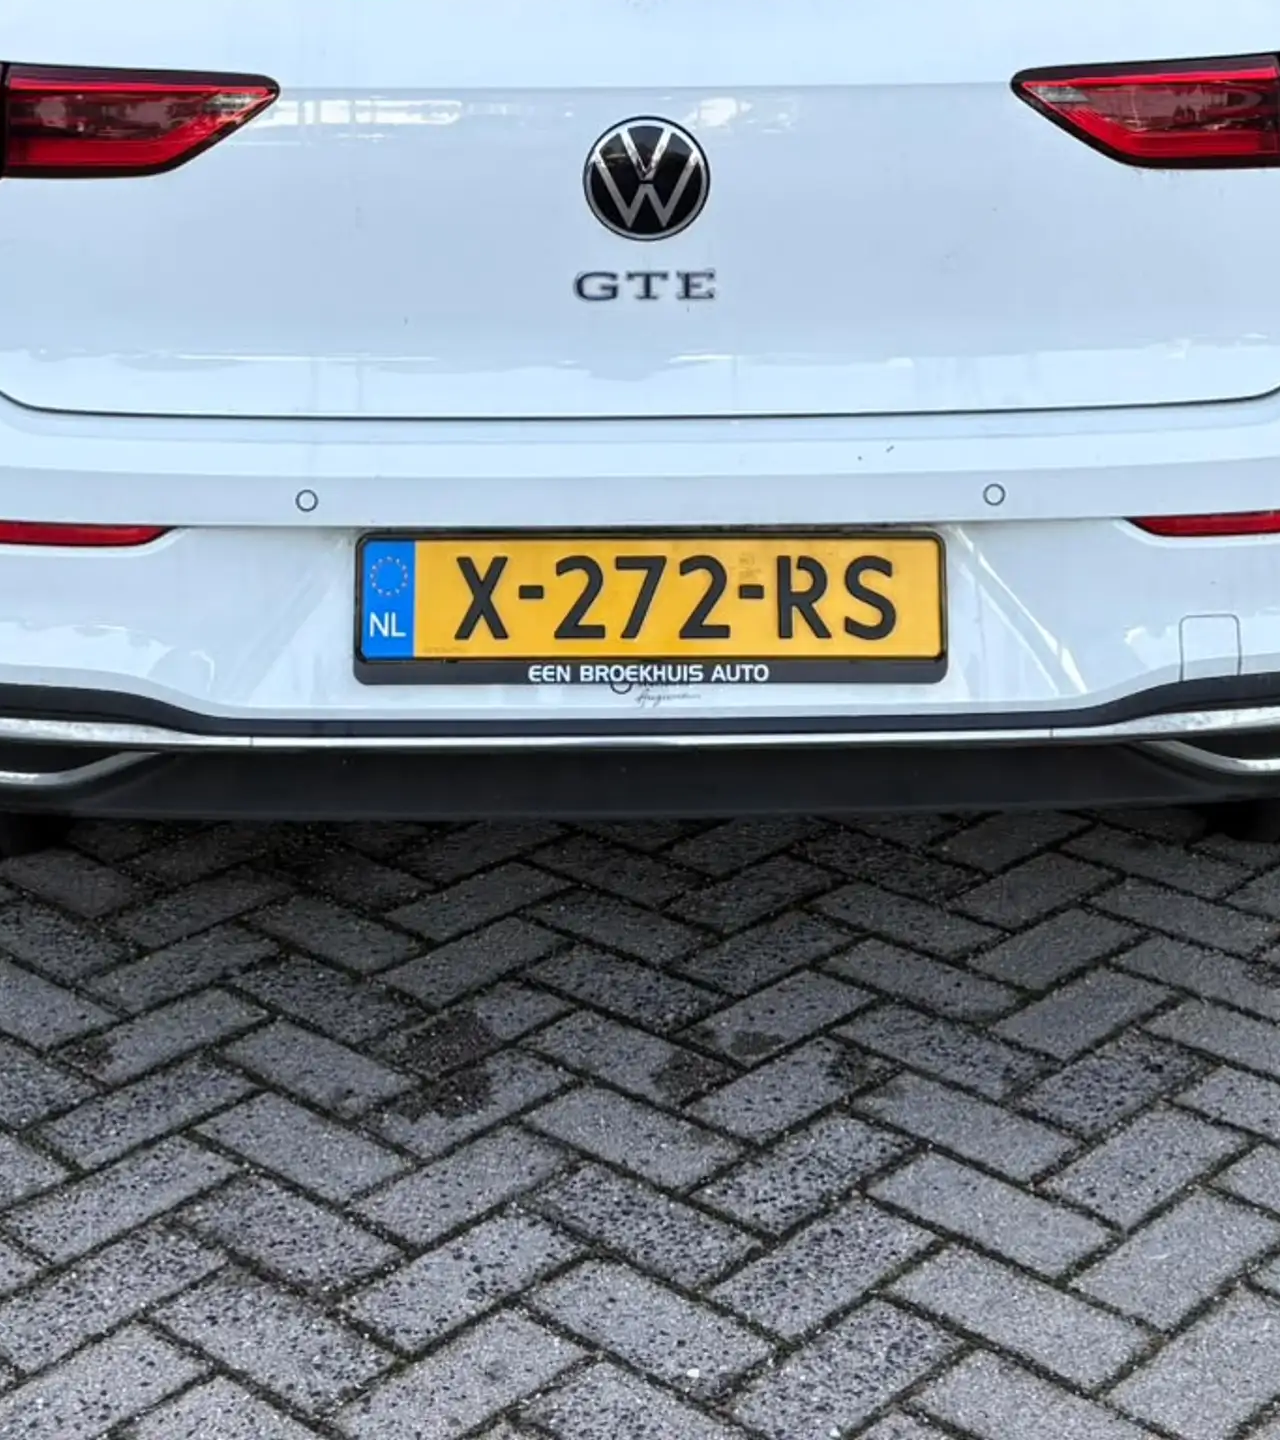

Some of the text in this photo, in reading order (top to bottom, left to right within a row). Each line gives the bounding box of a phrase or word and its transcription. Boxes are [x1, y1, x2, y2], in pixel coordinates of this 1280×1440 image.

[574, 271, 716, 301] GTE
[455, 554, 898, 641] X-272-RS
[369, 611, 407, 638] NL
[527, 662, 770, 683] EEN BROEKHUIS AUTO
